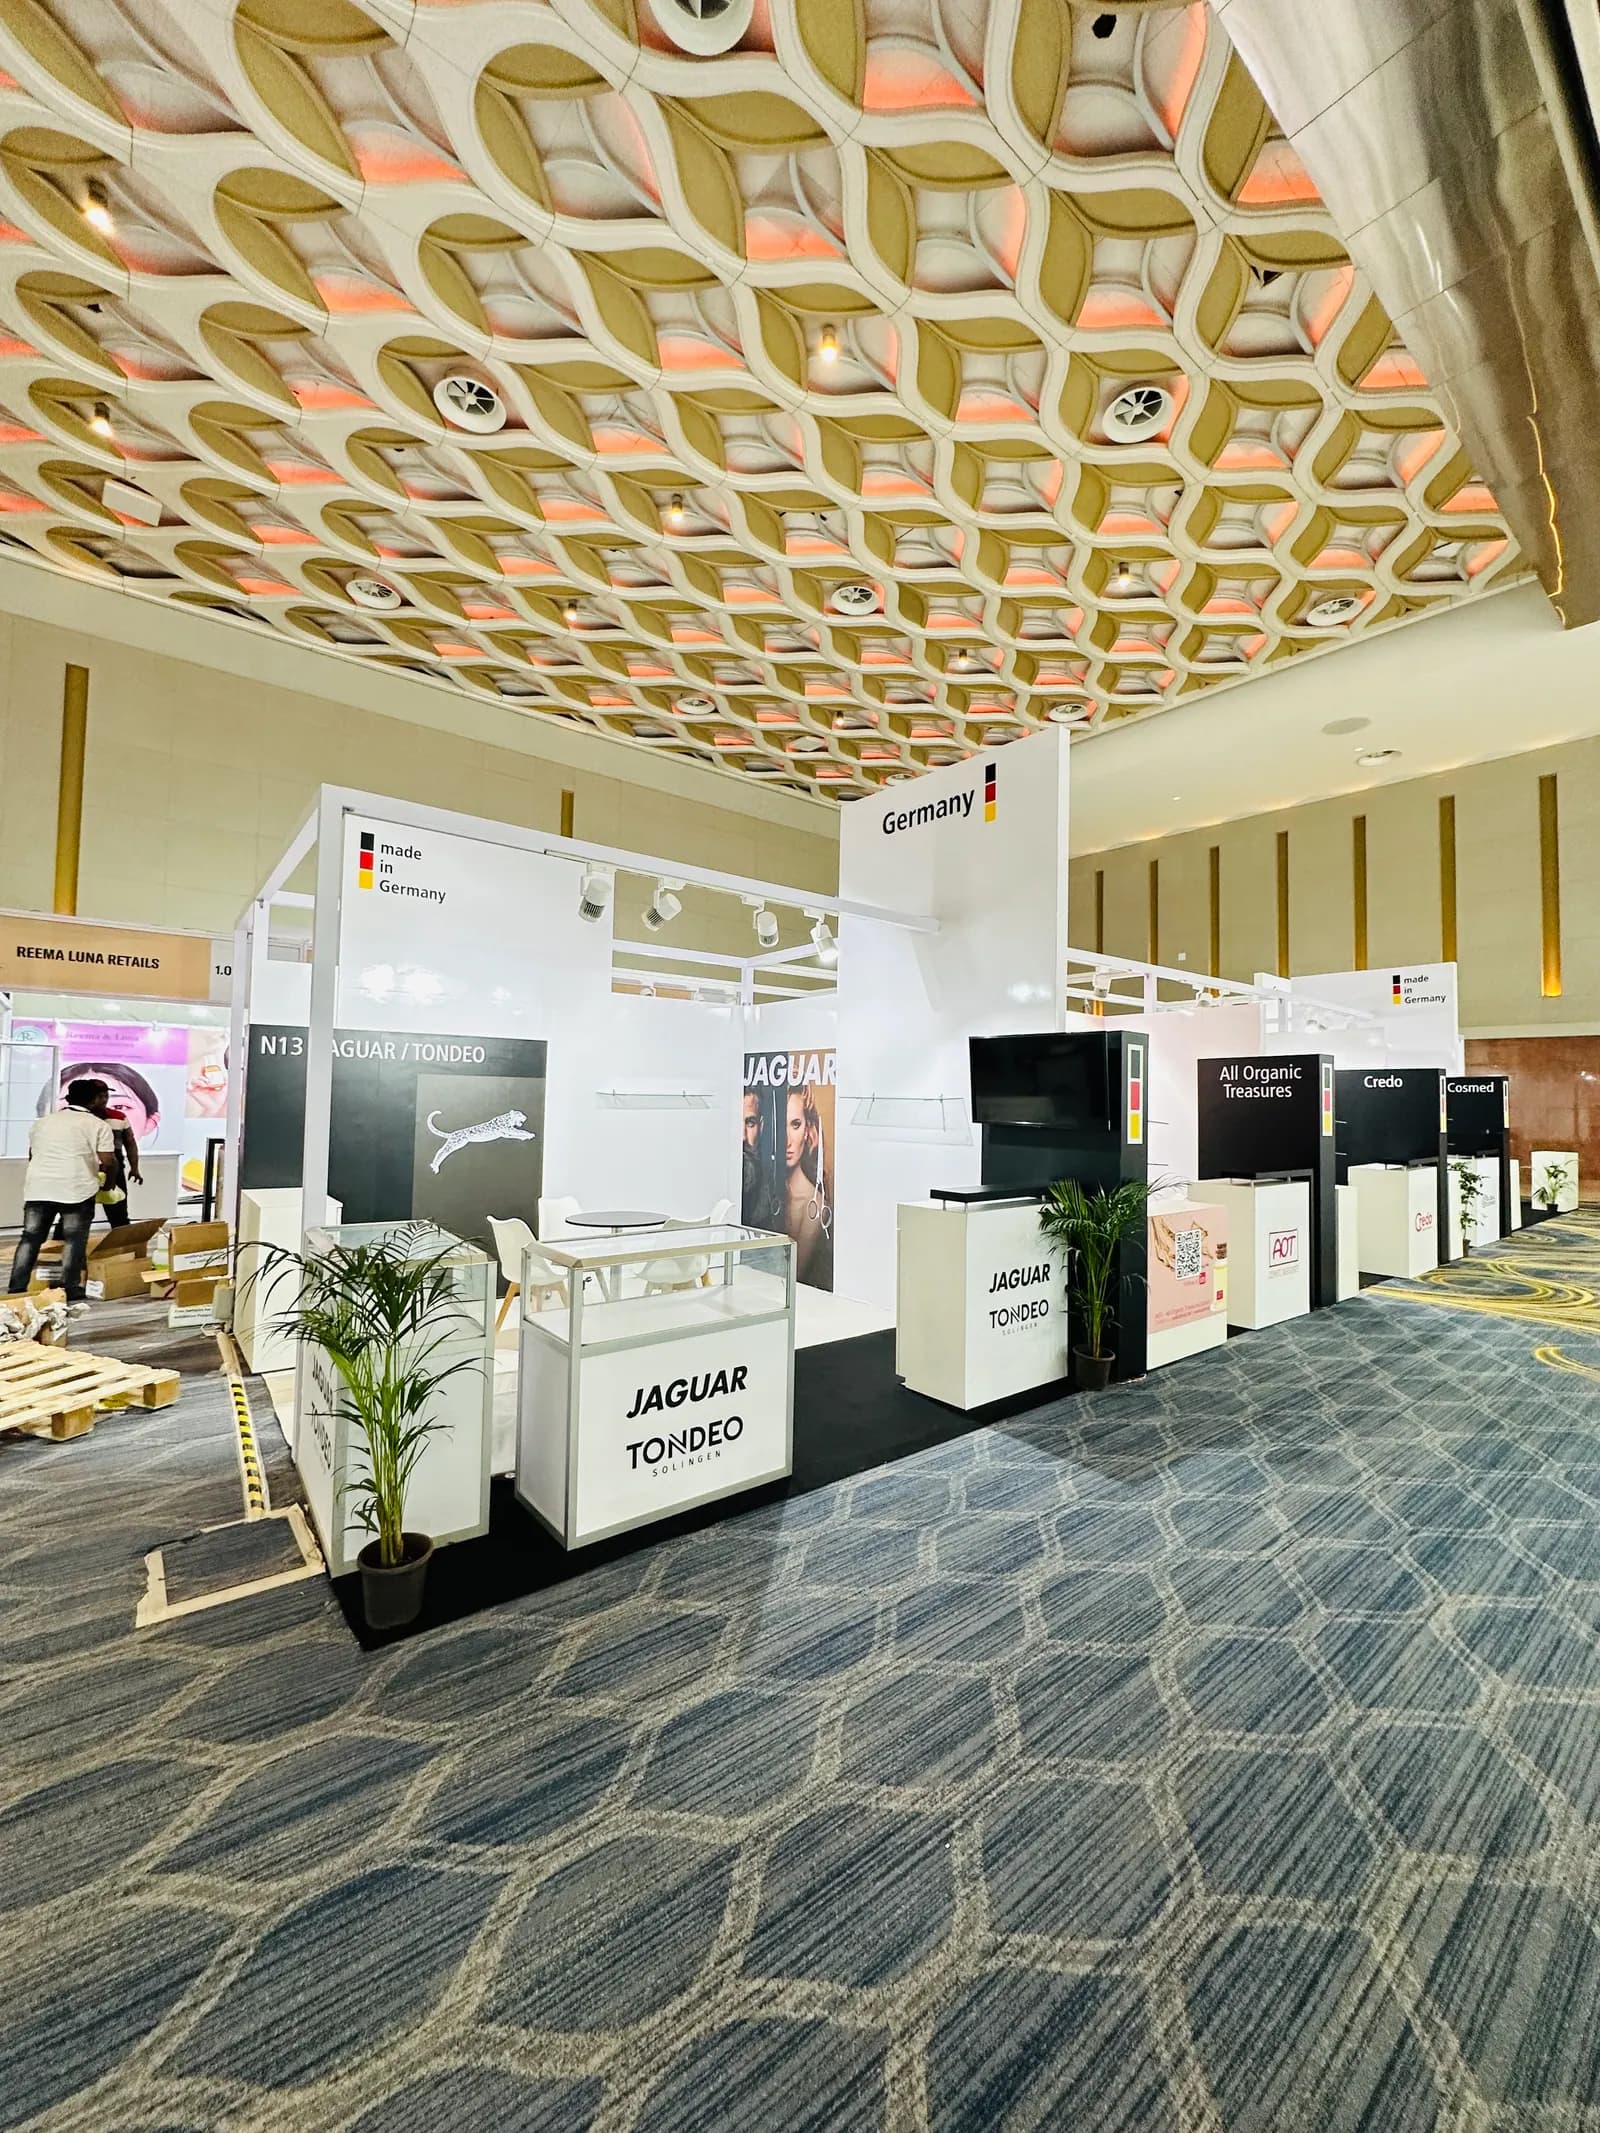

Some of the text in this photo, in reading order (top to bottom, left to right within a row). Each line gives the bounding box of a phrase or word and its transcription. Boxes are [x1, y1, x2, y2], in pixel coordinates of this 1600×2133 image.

[882, 789, 975, 835] Germany
[380, 844, 422, 860] made
[380, 859, 393, 874] in
[379, 879, 446, 904] Germany
[16, 946, 160, 969] REEMA LUNA RETAILS
[1403, 975, 1429, 984] made
[1404, 995, 1446, 1004] Germany
[260, 1035, 304, 1056] N13
[332, 1039, 396, 1060] AGUAR
[412, 1043, 485, 1063] TONDEO
[743, 1053, 838, 1087] JAGUAR
[1219, 1063, 1302, 1084] All Organic
[1363, 1074, 1403, 1088] Credo
[1223, 1083, 1292, 1098] Treasures
[1447, 1082, 1495, 1093] Cosmed
[1272, 1235, 1297, 1260] AOT
[989, 1263, 1051, 1294] JAGUAR
[989, 1299, 1049, 1329] TONDEO
[626, 1365, 748, 1419] JAGUAR
[626, 1415, 744, 1469] TONDEO
[652, 1450, 722, 1477] SOLINGEN
